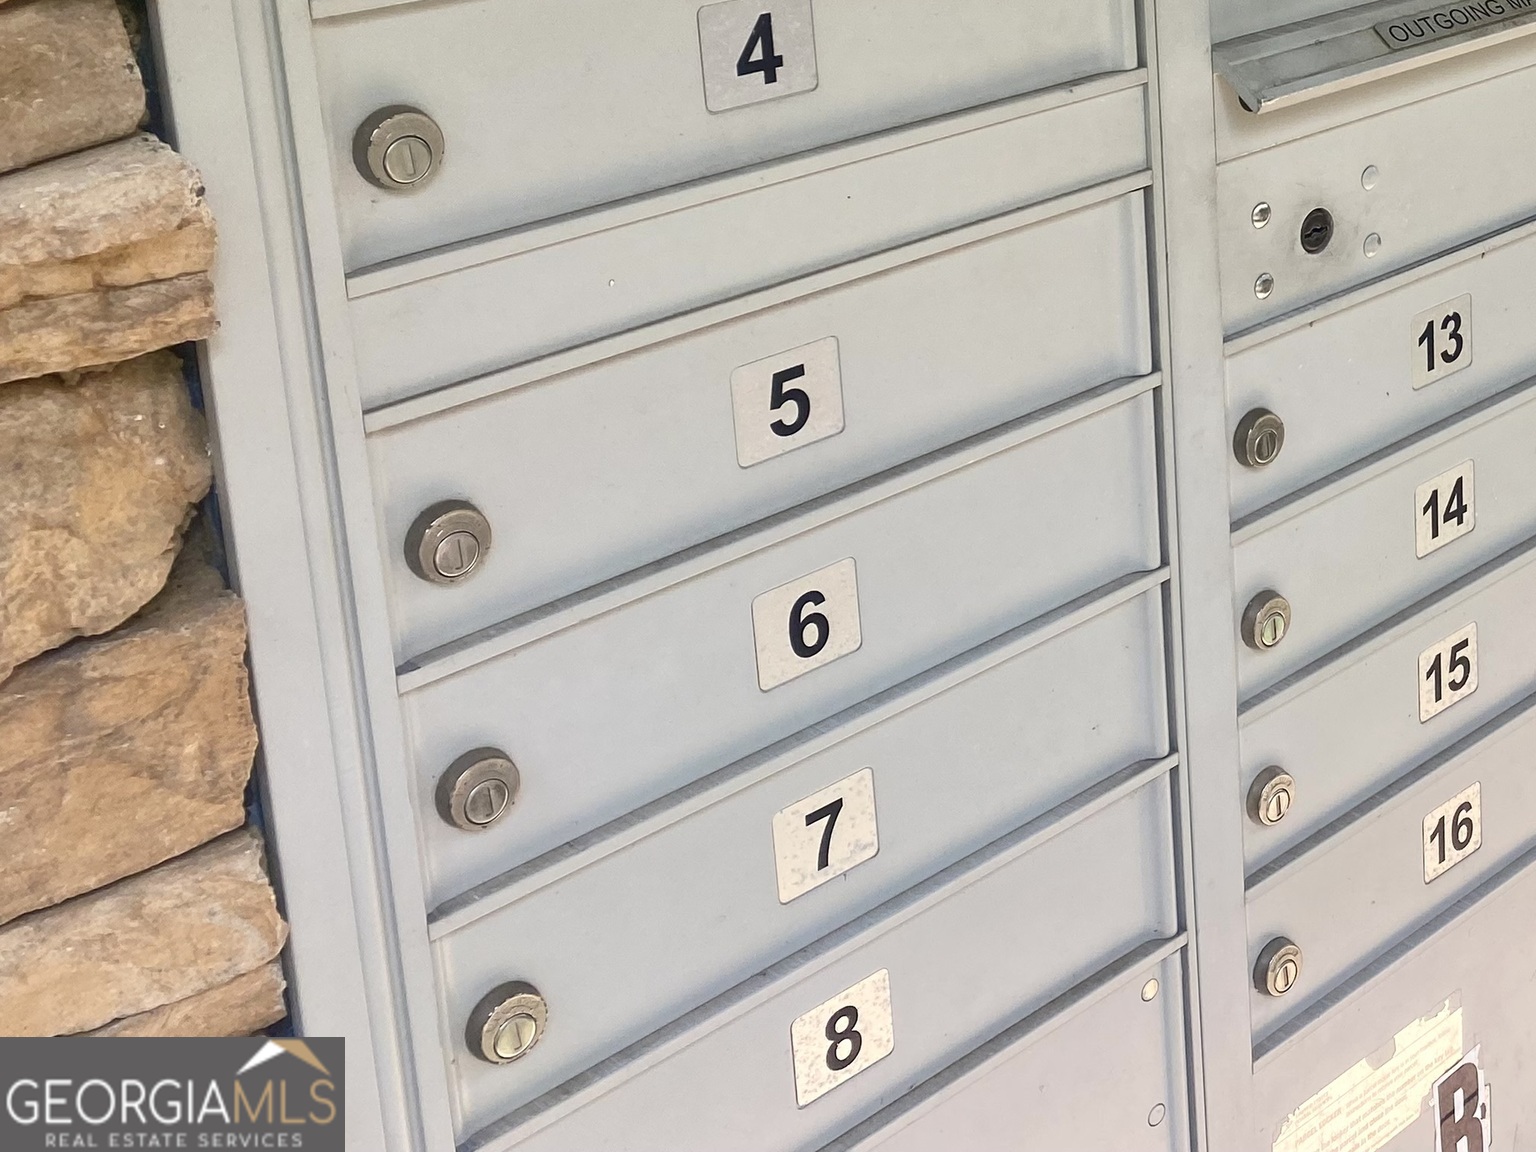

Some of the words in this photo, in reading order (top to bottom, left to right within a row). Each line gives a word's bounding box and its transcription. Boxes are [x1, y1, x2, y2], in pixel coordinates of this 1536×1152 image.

[737, 13, 783, 84] 4
[1388, 0, 1505, 42] OUTGOING
[1419, 312, 1463, 372] 13
[770, 364, 810, 436] 5
[1423, 476, 1467, 539] 14
[789, 591, 829, 658] 6
[1426, 638, 1470, 702] 15
[805, 798, 843, 871] 7
[1430, 802, 1473, 864] 16
[826, 1006, 862, 1071] 8
[1437, 1063, 1484, 1152] B
